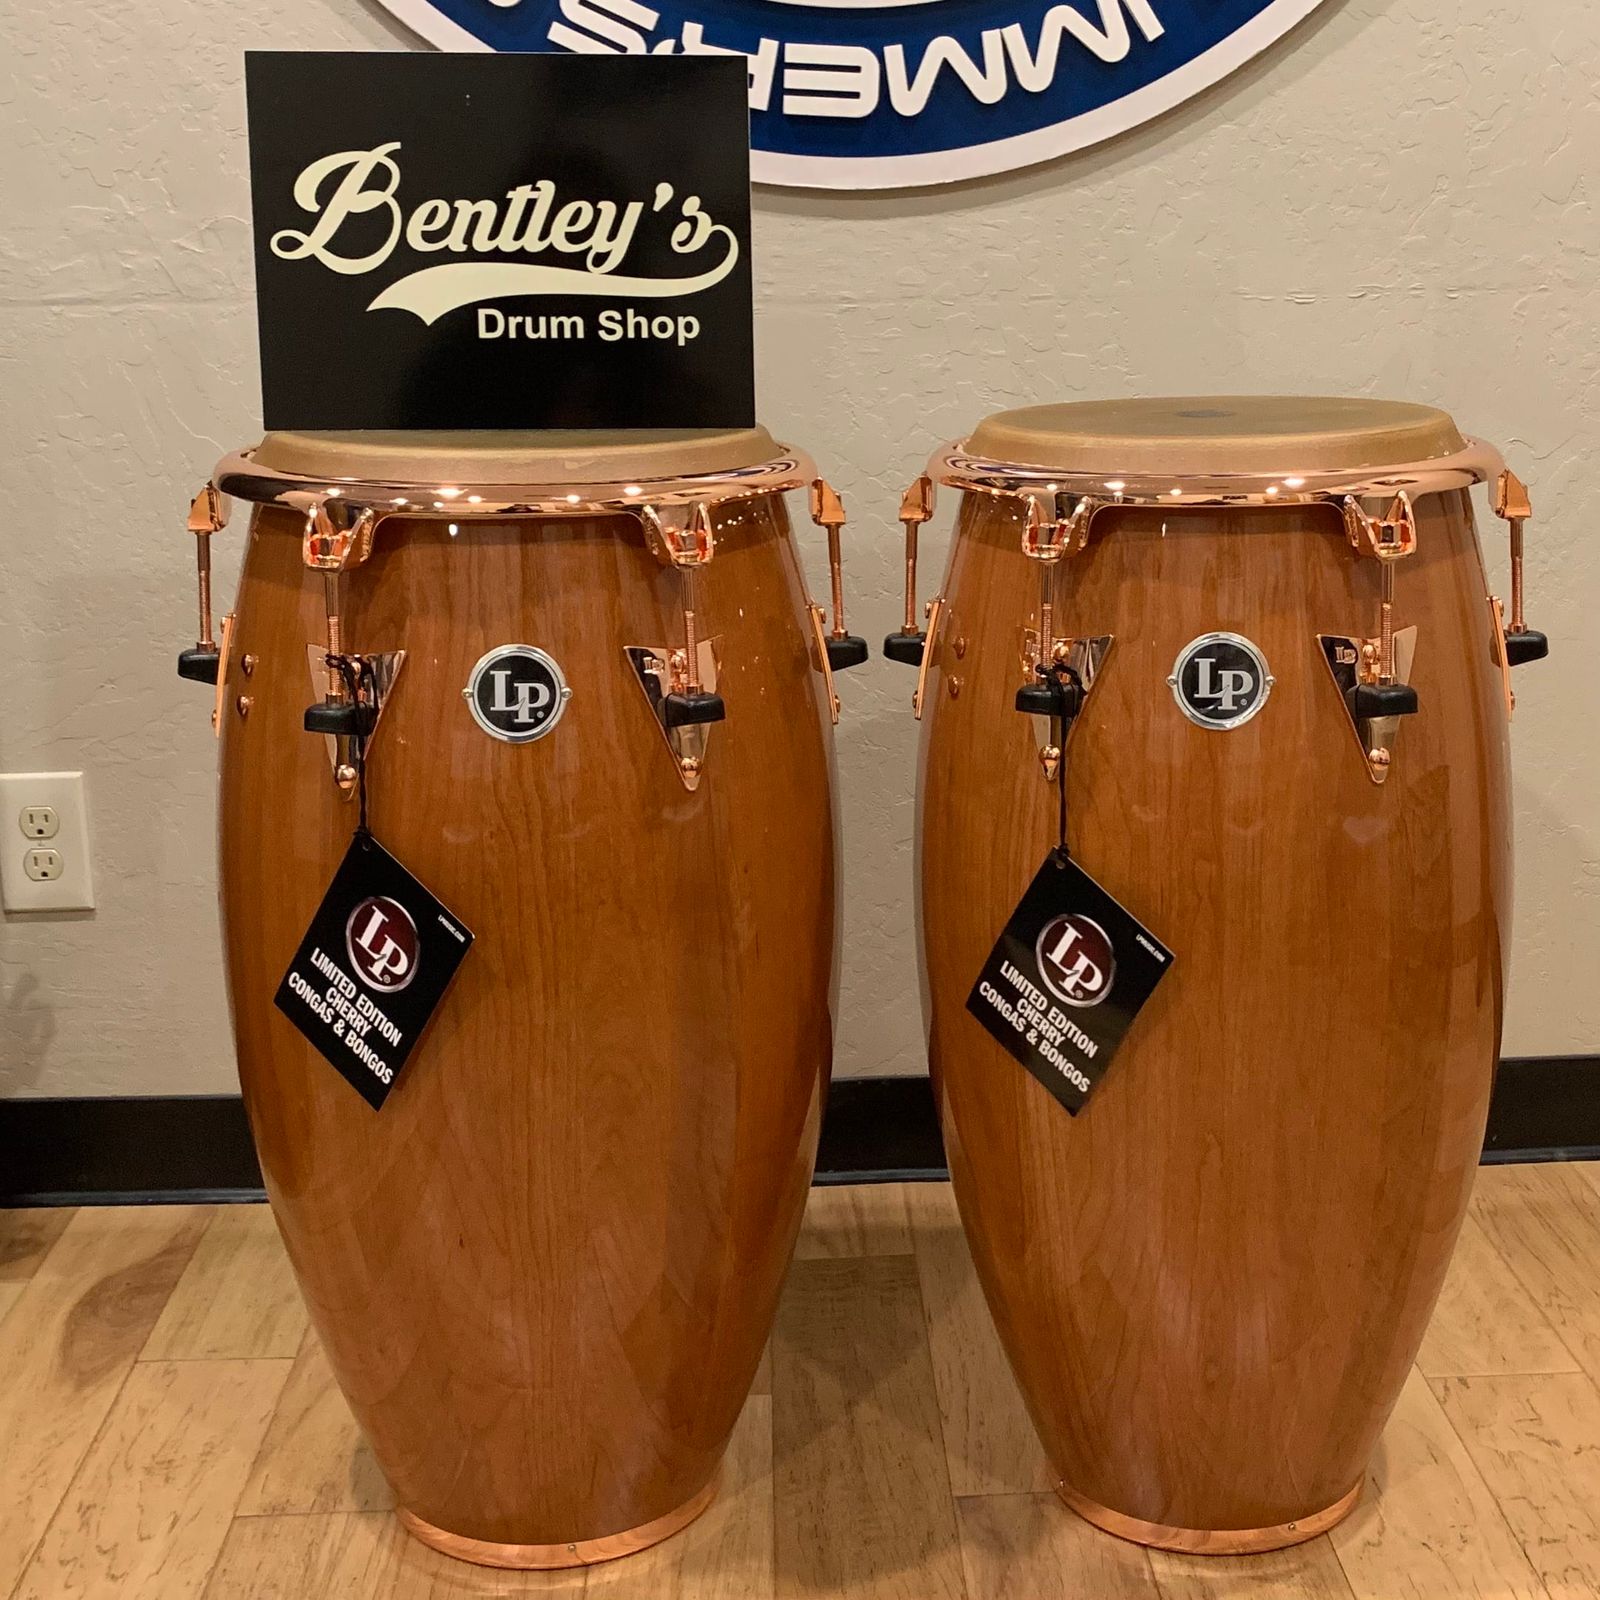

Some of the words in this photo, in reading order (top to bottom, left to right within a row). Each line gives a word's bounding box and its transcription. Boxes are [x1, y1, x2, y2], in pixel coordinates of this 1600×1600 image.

[270, 141, 739, 276] Bentley's
[477, 308, 585, 340] Drum
[597, 308, 701, 346] Shop
[490, 670, 550, 723] LP
[1193, 658, 1254, 710] LP
[288, 971, 336, 1024] CONGAS
[333, 1019, 346, 1038] &
[345, 1030, 394, 1085] BONGOS
[310, 947, 358, 999] LIMITED
[355, 993, 403, 1048] EDITION
[325, 986, 374, 1038] CHERRY
[999, 960, 1048, 1012] LIMITED
[1047, 1005, 1099, 1059] EDITION
[1016, 998, 1066, 1048] CHERRY
[979, 980, 1026, 1033] CONGAS
[1025, 1028, 1039, 1046] &
[1038, 1040, 1091, 1093] BONGOS
